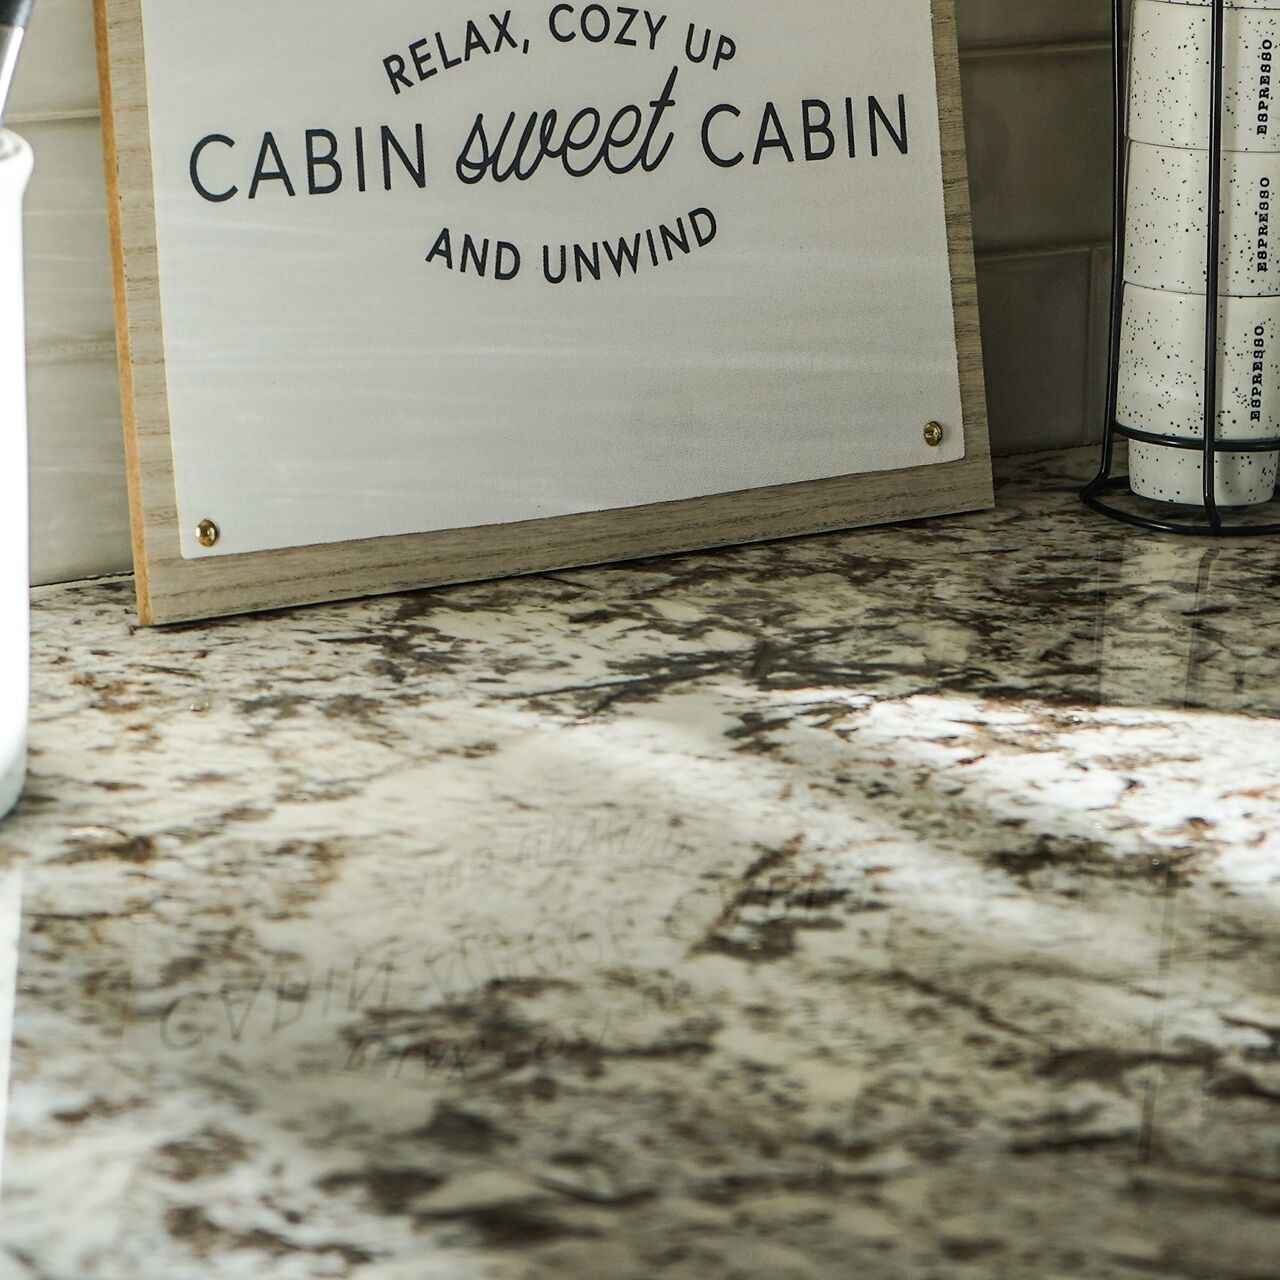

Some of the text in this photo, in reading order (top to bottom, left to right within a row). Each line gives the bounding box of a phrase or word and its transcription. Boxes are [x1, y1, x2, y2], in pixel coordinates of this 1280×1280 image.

[383, 4, 737, 95] RELAX, COZY UP
[1256, 39, 1273, 135] ESPRESSO
[190, 66, 908, 203] CABIN sweet CABIN
[426, 207, 717, 284] AND UNWIND
[1257, 177, 1270, 273] ESPRESSO
[1250, 325, 1266, 423] ESPRESSO
